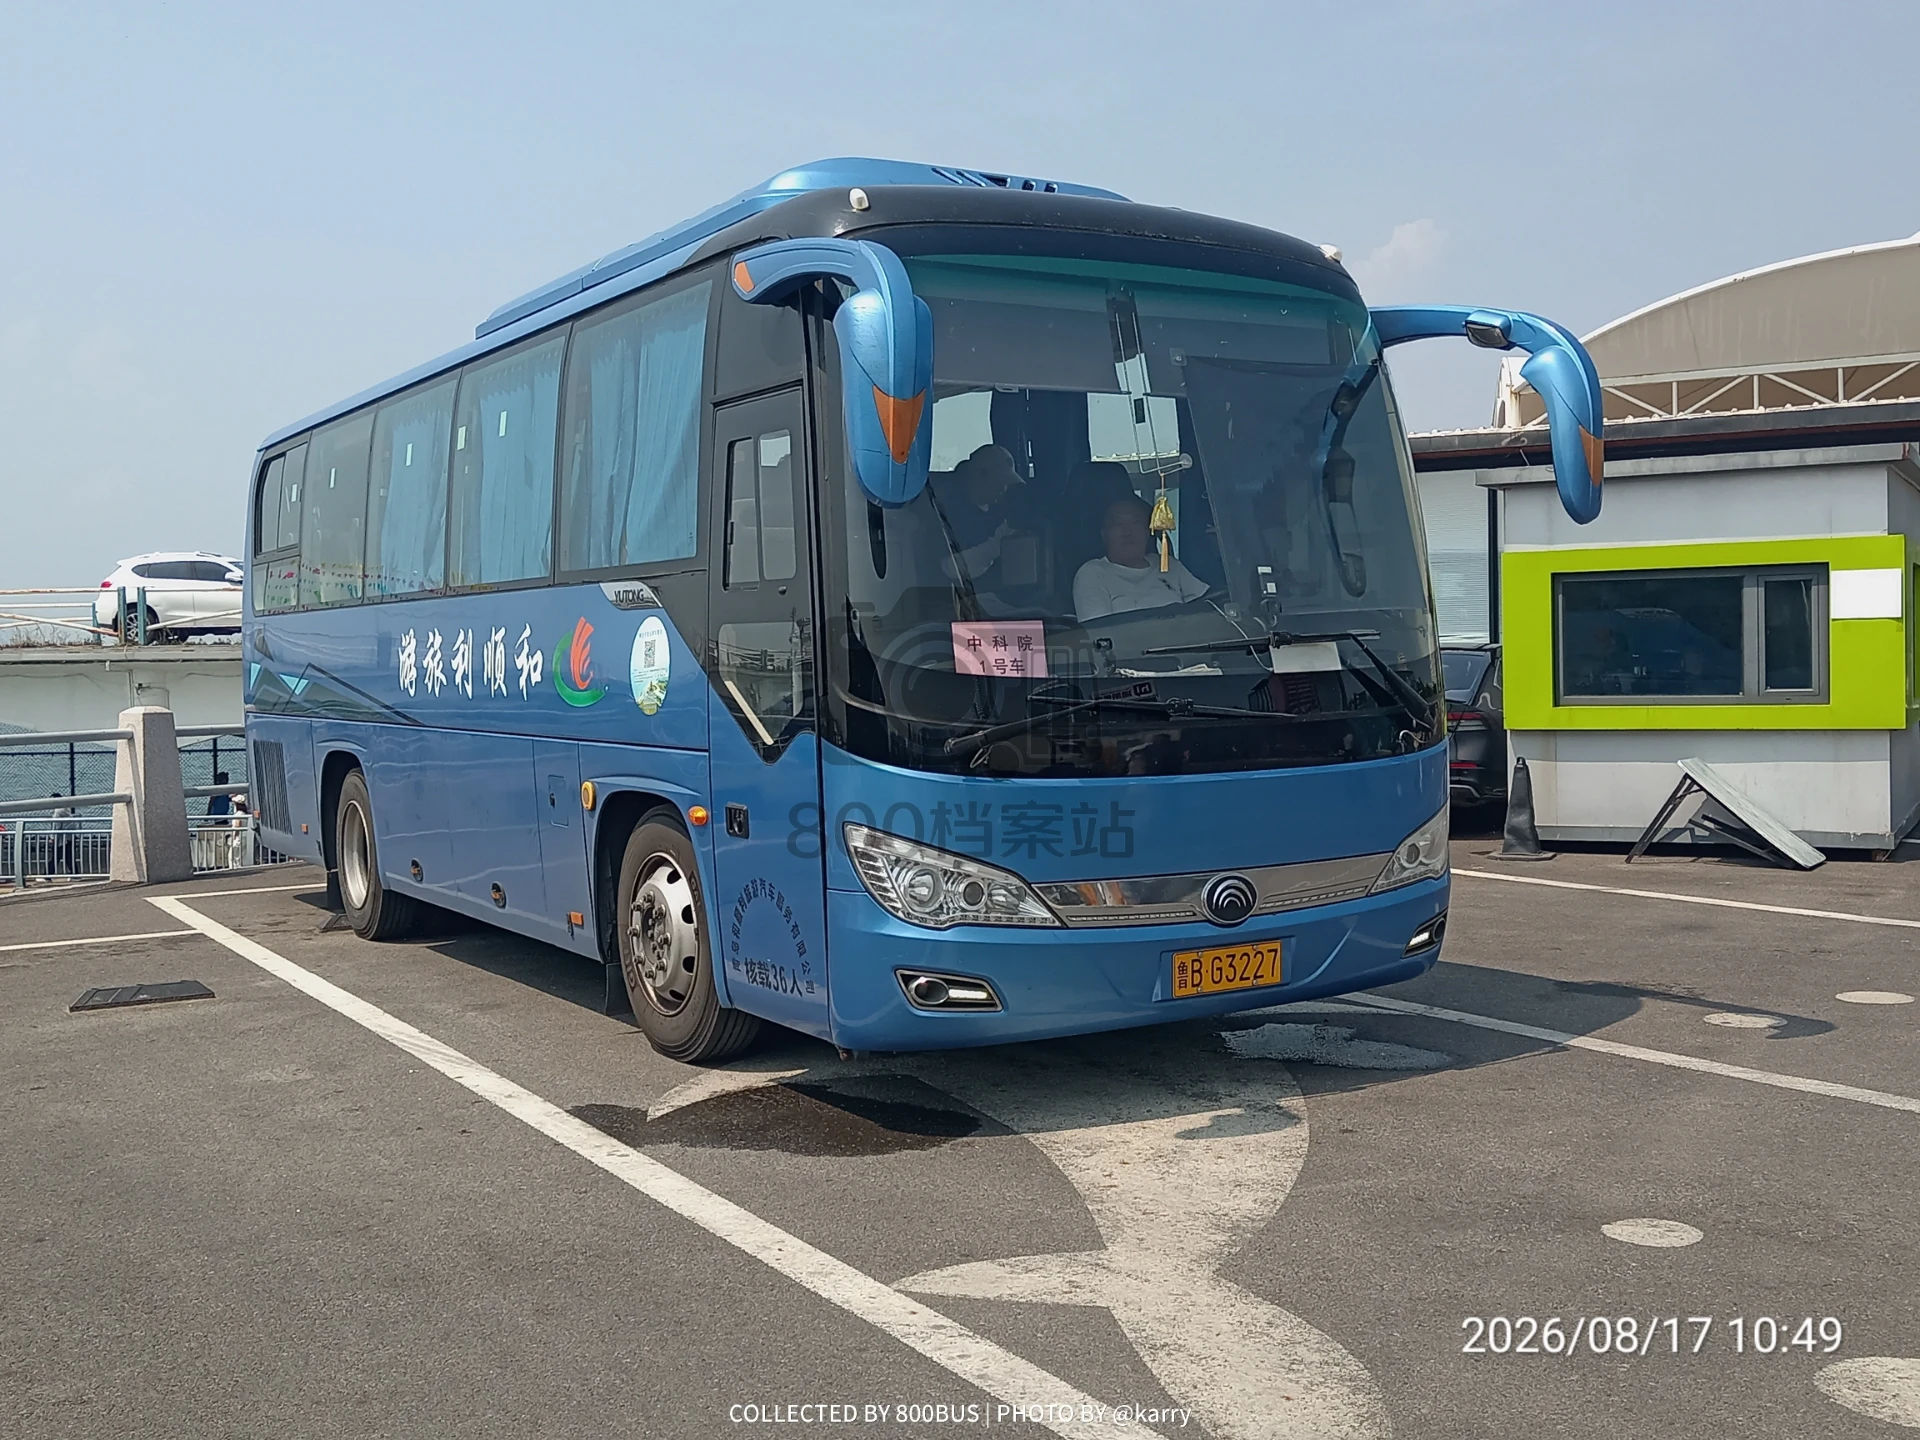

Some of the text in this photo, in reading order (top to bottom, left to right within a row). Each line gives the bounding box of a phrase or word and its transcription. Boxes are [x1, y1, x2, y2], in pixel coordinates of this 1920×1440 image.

[613, 588, 645, 604] YUTONG
[967, 634, 1034, 653] 中科院
[979, 657, 1026, 675] 1号车
[743, 956, 803, 998] 核载36人
